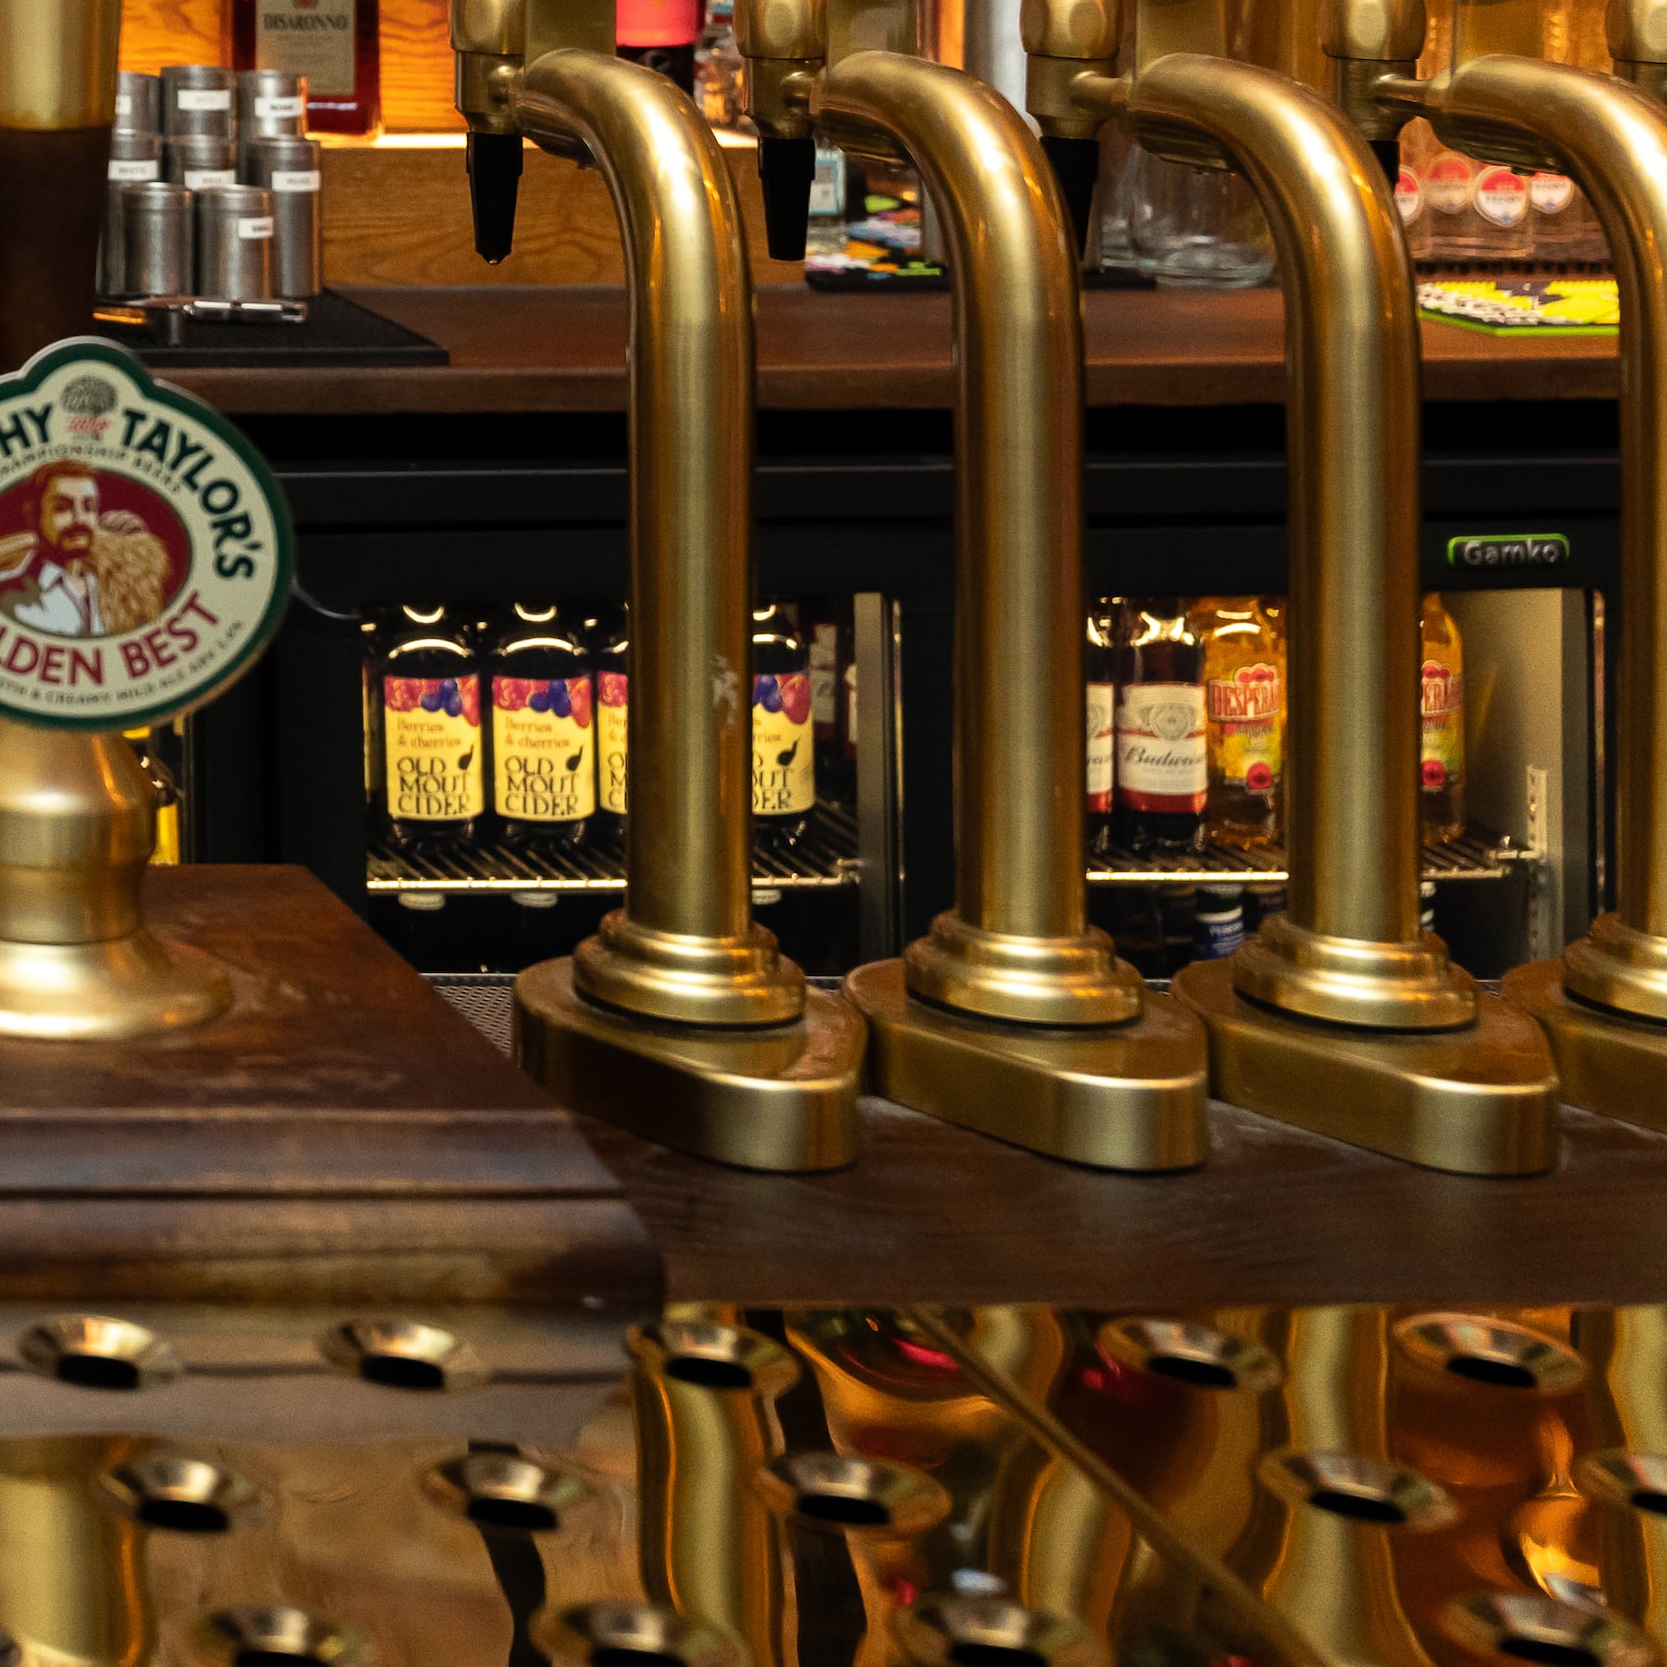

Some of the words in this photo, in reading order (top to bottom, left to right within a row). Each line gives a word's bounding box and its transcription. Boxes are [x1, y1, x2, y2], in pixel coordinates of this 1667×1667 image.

[264, 13, 350, 32] DISARONNO
[117, 408, 267, 584] TAYLOR'S
[1463, 539, 1560, 565] Gamko
[118, 590, 220, 680] BEST
[396, 755, 446, 776] OLD
[504, 755, 554, 776] OLD
[399, 772, 470, 793] MOUT
[506, 772, 580, 793] MOUT
[397, 791, 470, 816] CIDER
[504, 791, 579, 816] CIDER
